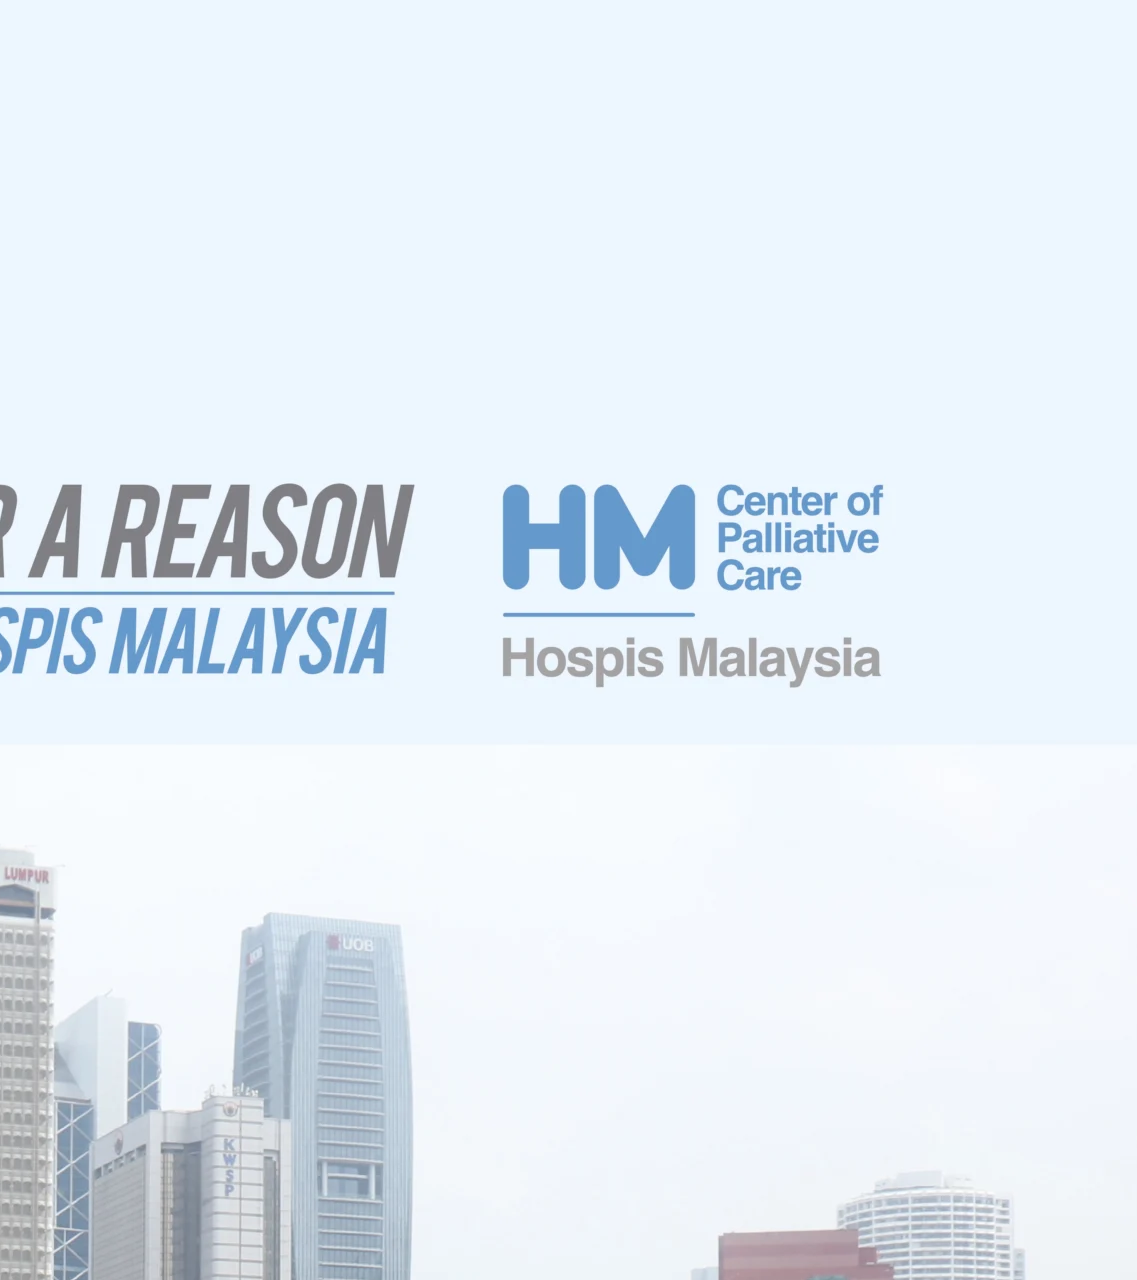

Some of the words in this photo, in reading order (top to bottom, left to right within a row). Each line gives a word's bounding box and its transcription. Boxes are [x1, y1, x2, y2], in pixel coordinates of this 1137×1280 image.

[4, 866, 50, 883] LUMPUR
[342, 937, 375, 952] UOB
[223, 1138, 236, 1197] KWSP
